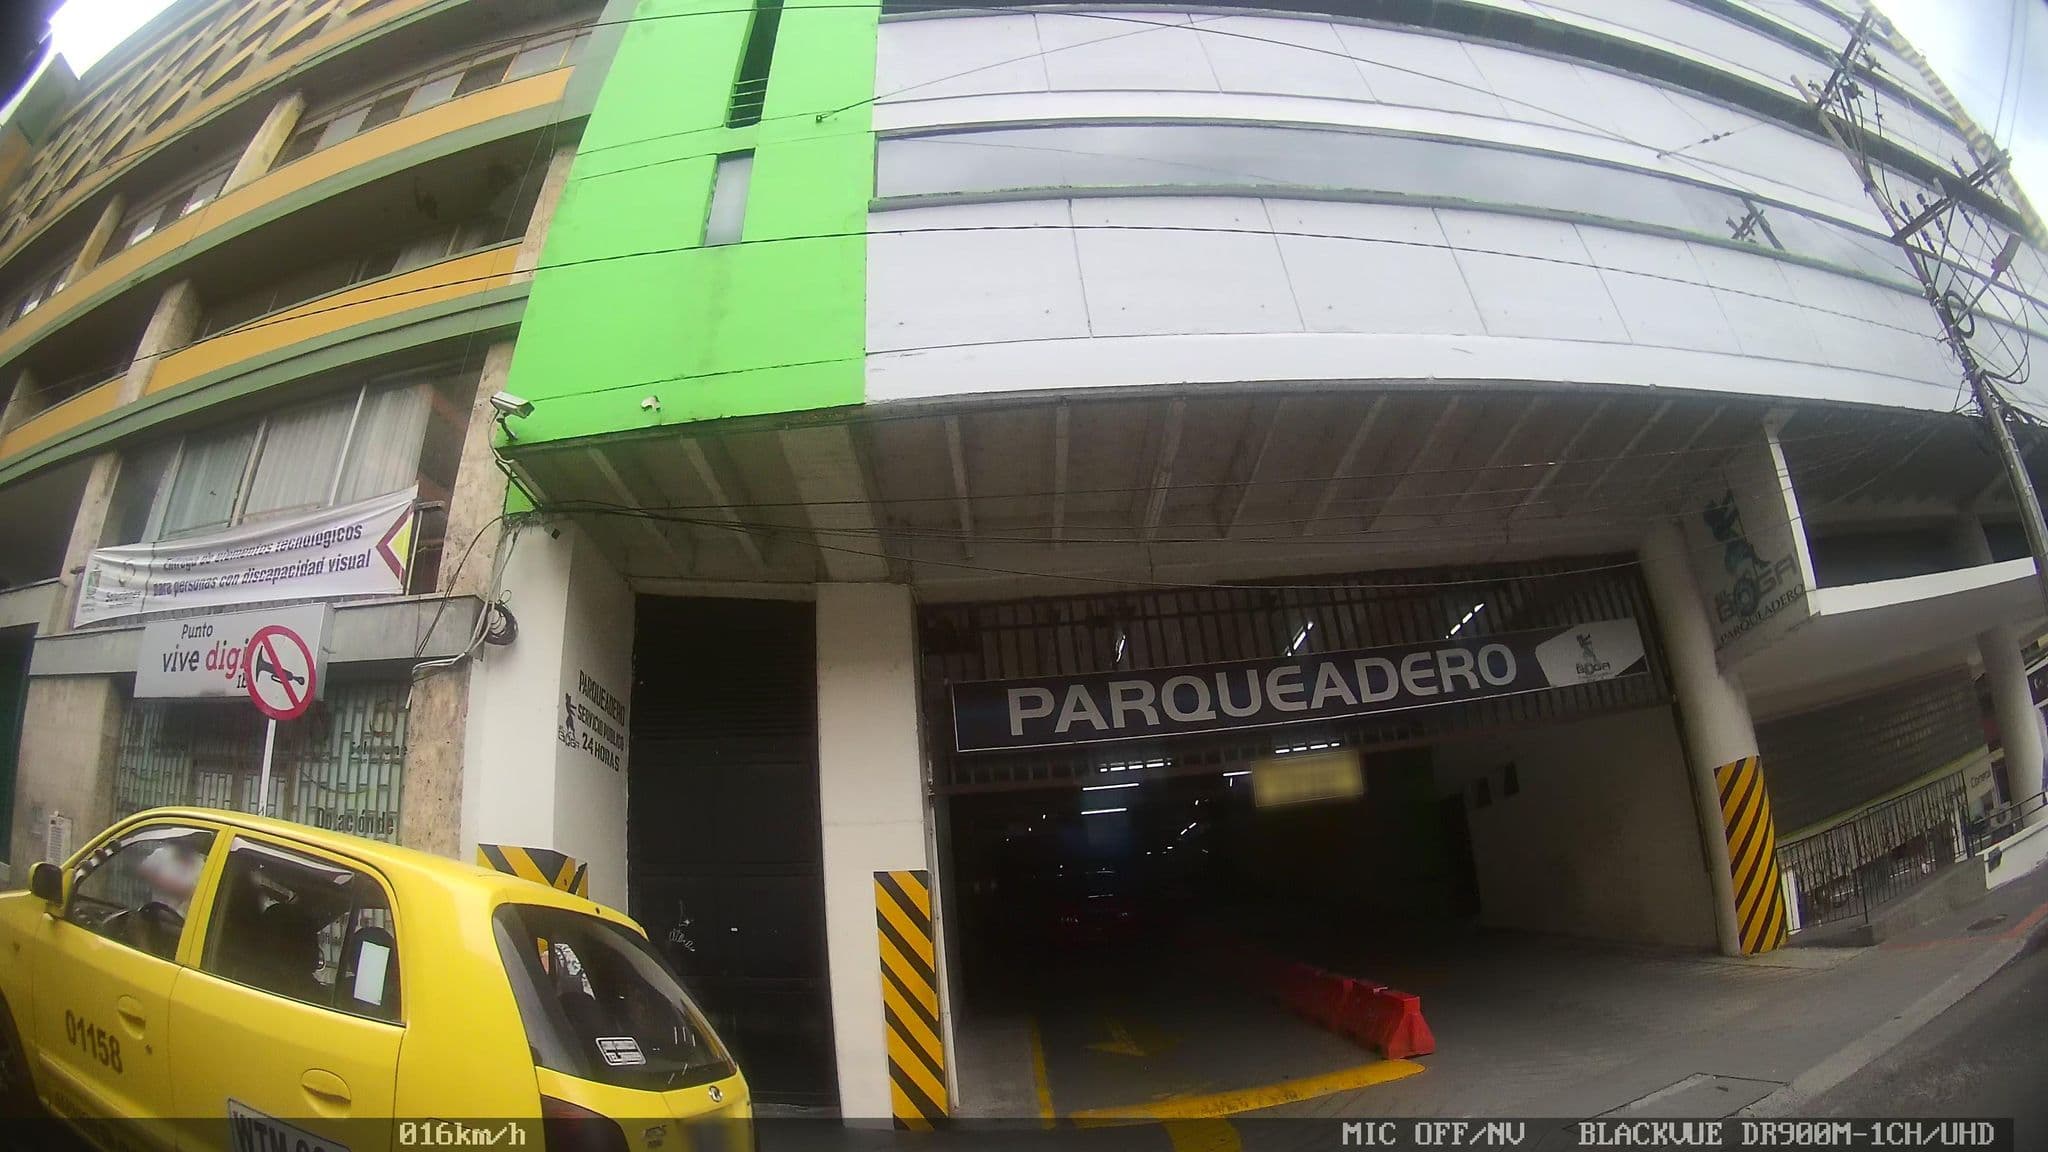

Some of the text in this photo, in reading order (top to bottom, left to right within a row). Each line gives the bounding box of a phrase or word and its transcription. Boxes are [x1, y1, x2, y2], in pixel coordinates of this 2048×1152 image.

[174, 575, 218, 598] personas
[220, 572, 240, 588] con
[241, 555, 325, 585] discapacidad
[328, 548, 371, 572] visual
[181, 622, 214, 640] Punto
[162, 644, 200, 673] vive
[579, 669, 626, 727] PARQUEADERO
[1006, 642, 1516, 738] PARQUEADERO
[582, 732, 621, 772] 24 HORAS
[65, 1009, 123, 1075] 01158
